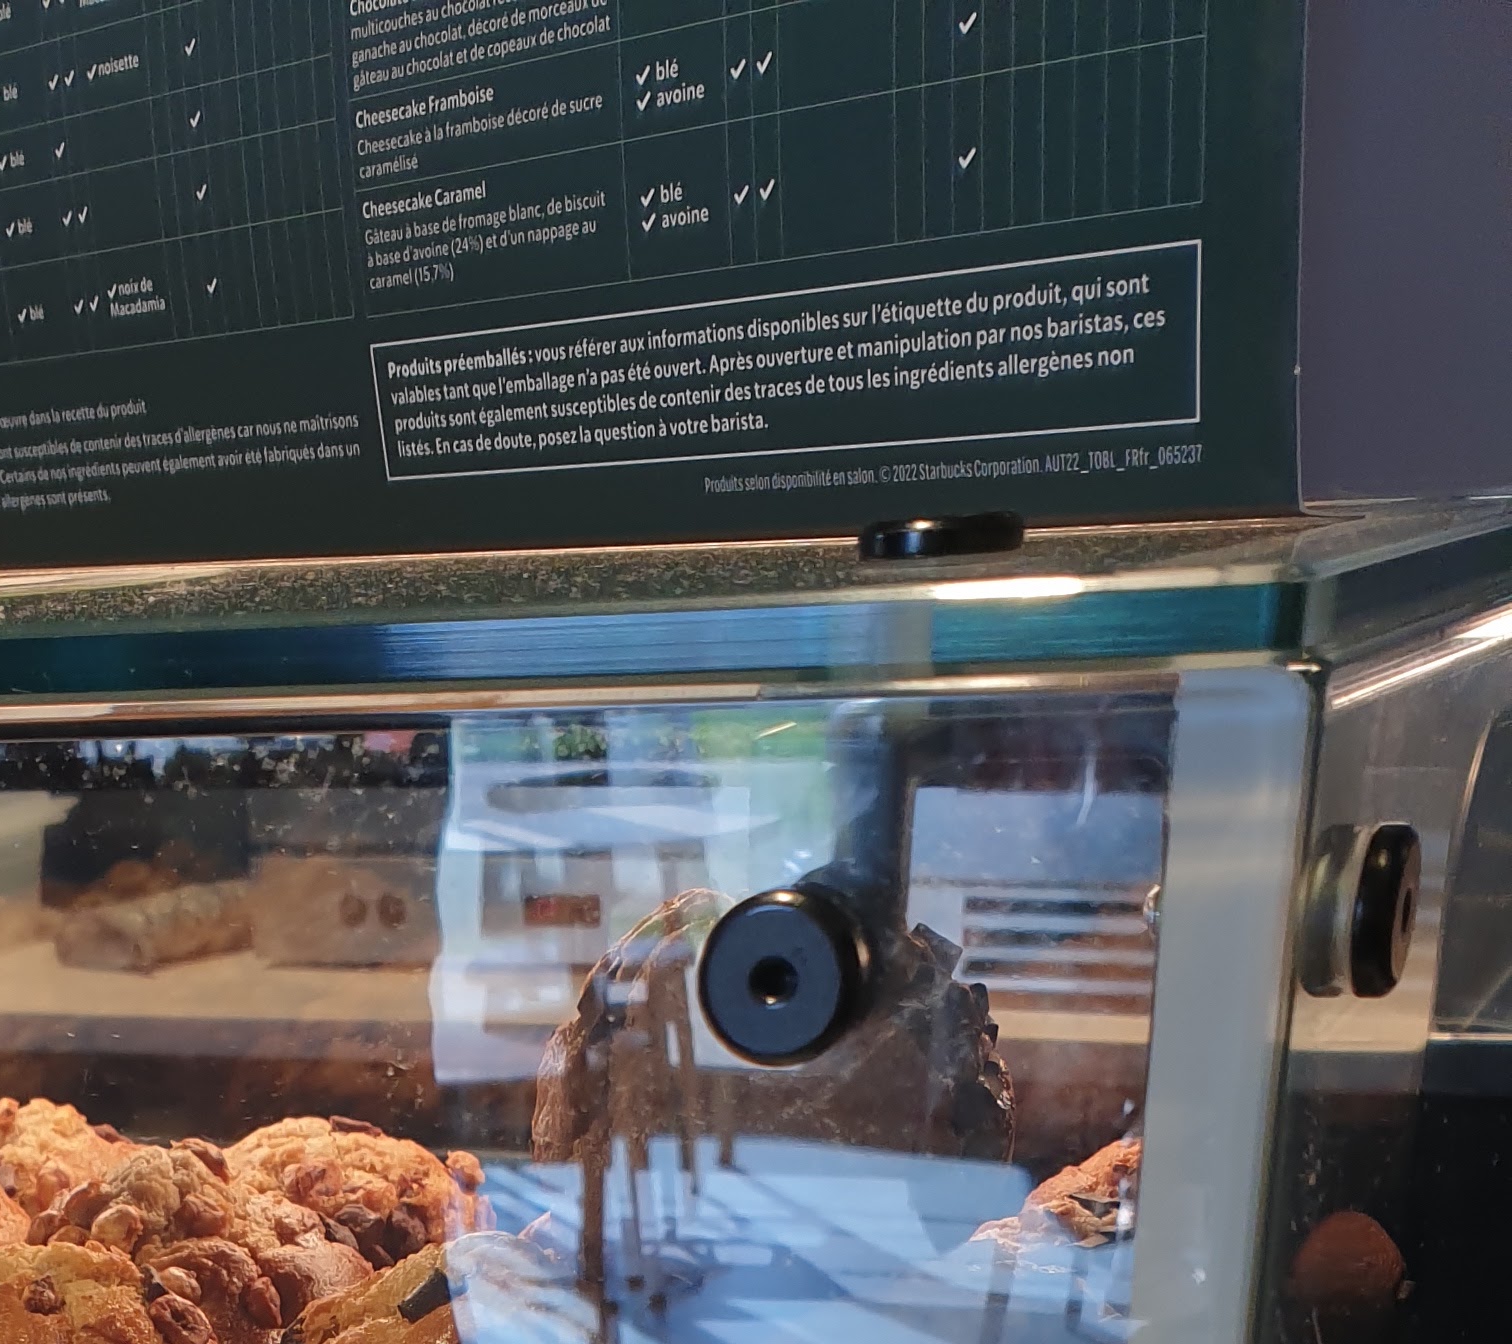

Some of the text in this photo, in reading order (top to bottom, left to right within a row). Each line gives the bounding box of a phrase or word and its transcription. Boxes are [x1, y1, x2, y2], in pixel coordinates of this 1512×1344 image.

[98, 54, 139, 76] noisette
[655, 58, 679, 81] blé
[355, 86, 493, 127] Cheesecake Framboise
[656, 83, 705, 107] avoine
[362, 180, 485, 218] Cheesecake Caramel
[660, 182, 683, 203] blé
[662, 206, 709, 228] avoine
[110, 296, 166, 318] Macadamia
[387, 274, 1148, 378] Produits préemballés vous référer aux informations disponibles sur l'étiquette du produit, qui sont
[391, 310, 1164, 404] valables tant que l'emballage n'a pas été ouvert. Après ouverture et manipulation par nos baristas, ces
[394, 348, 1133, 434] produits sont également susceptibles de contenir des traces de tous les ingrédients allergènes non
[397, 412, 768, 456] listés. En cas de doute, posez la question à votre barista.
[893, 462, 918, 482] 2022
[919, 458, 972, 480] Starbucks
